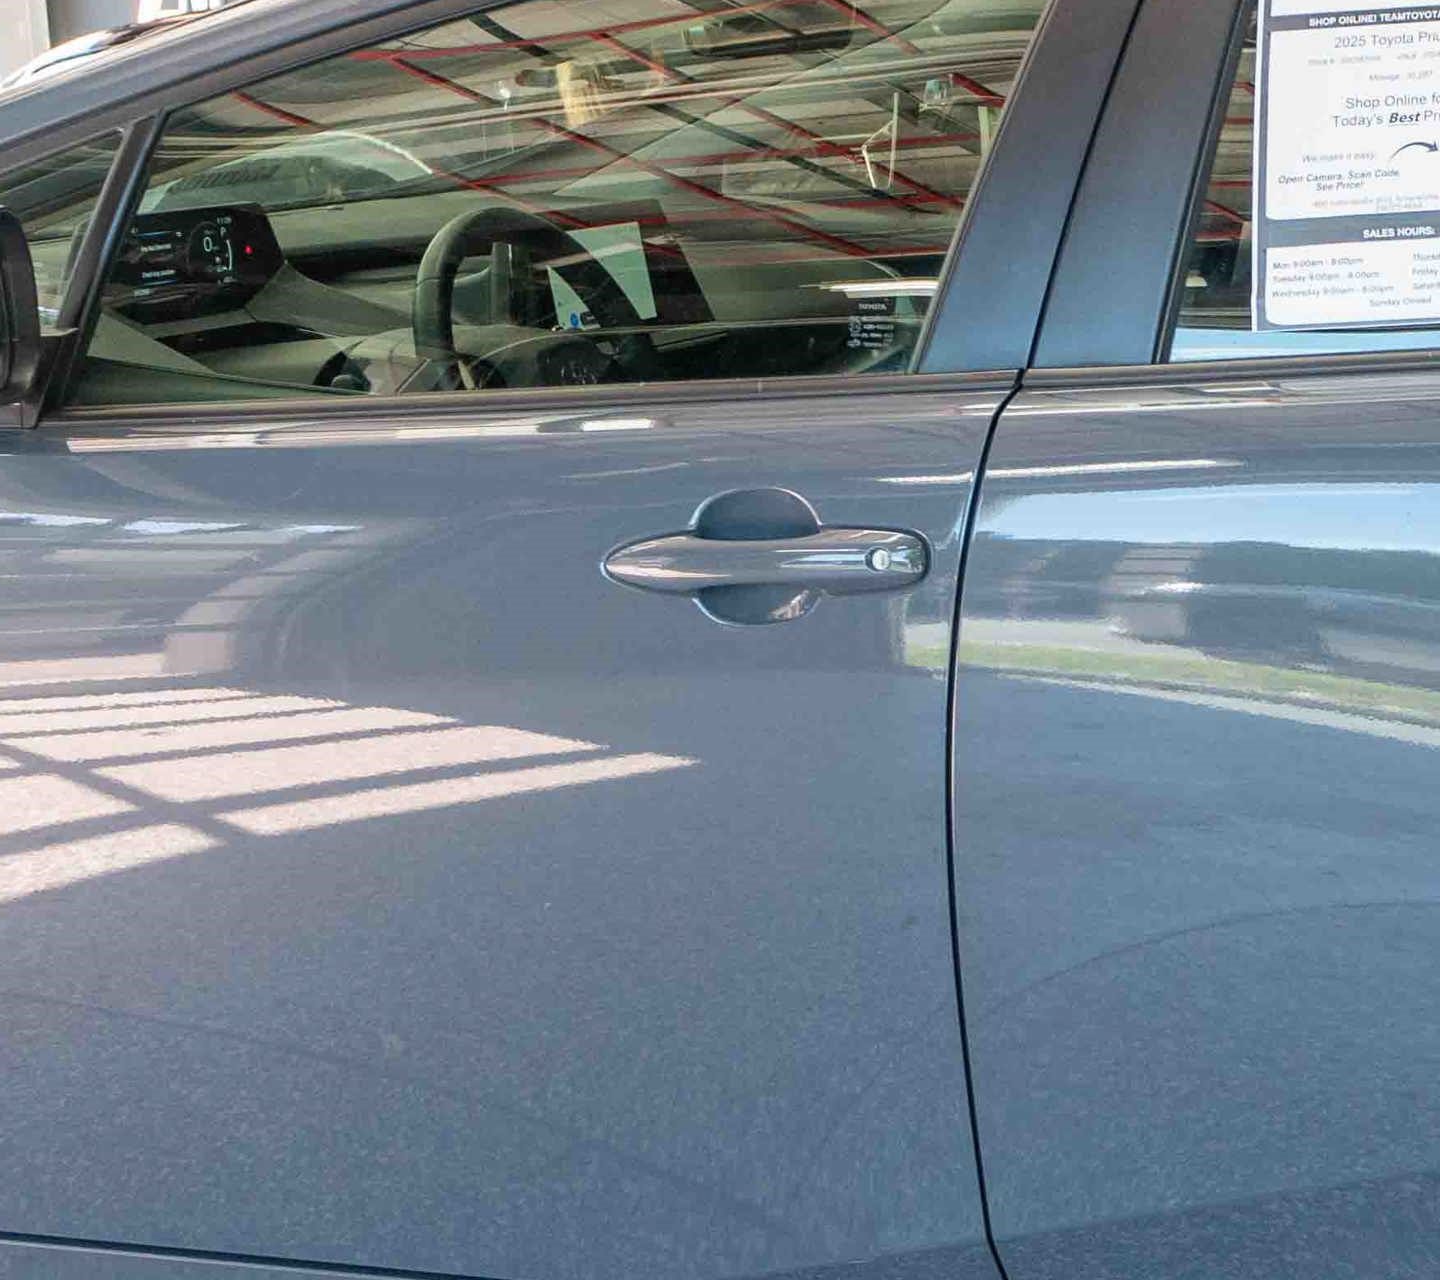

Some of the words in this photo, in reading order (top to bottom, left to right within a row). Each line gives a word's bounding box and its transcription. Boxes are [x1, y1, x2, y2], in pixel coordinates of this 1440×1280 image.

[1309, 16, 1336, 27] SHOP
[1338, 12, 1377, 25] ONLINE!
[1334, 36, 1367, 48] 2025
[1371, 33, 1413, 48] Toyota
[1346, 97, 1381, 110] Shop
[1384, 95, 1426, 107] Online
[1333, 114, 1383, 129] Today's
[1389, 112, 1420, 125] Best
[1278, 175, 1303, 185] Open
[1348, 170, 1372, 180] Scan
[1363, 228, 1395, 239] SALES
[1397, 226, 1435, 237] HOURS:
[203, 237, 212, 252] 0
[1412, 266, 1438, 277] Friday
